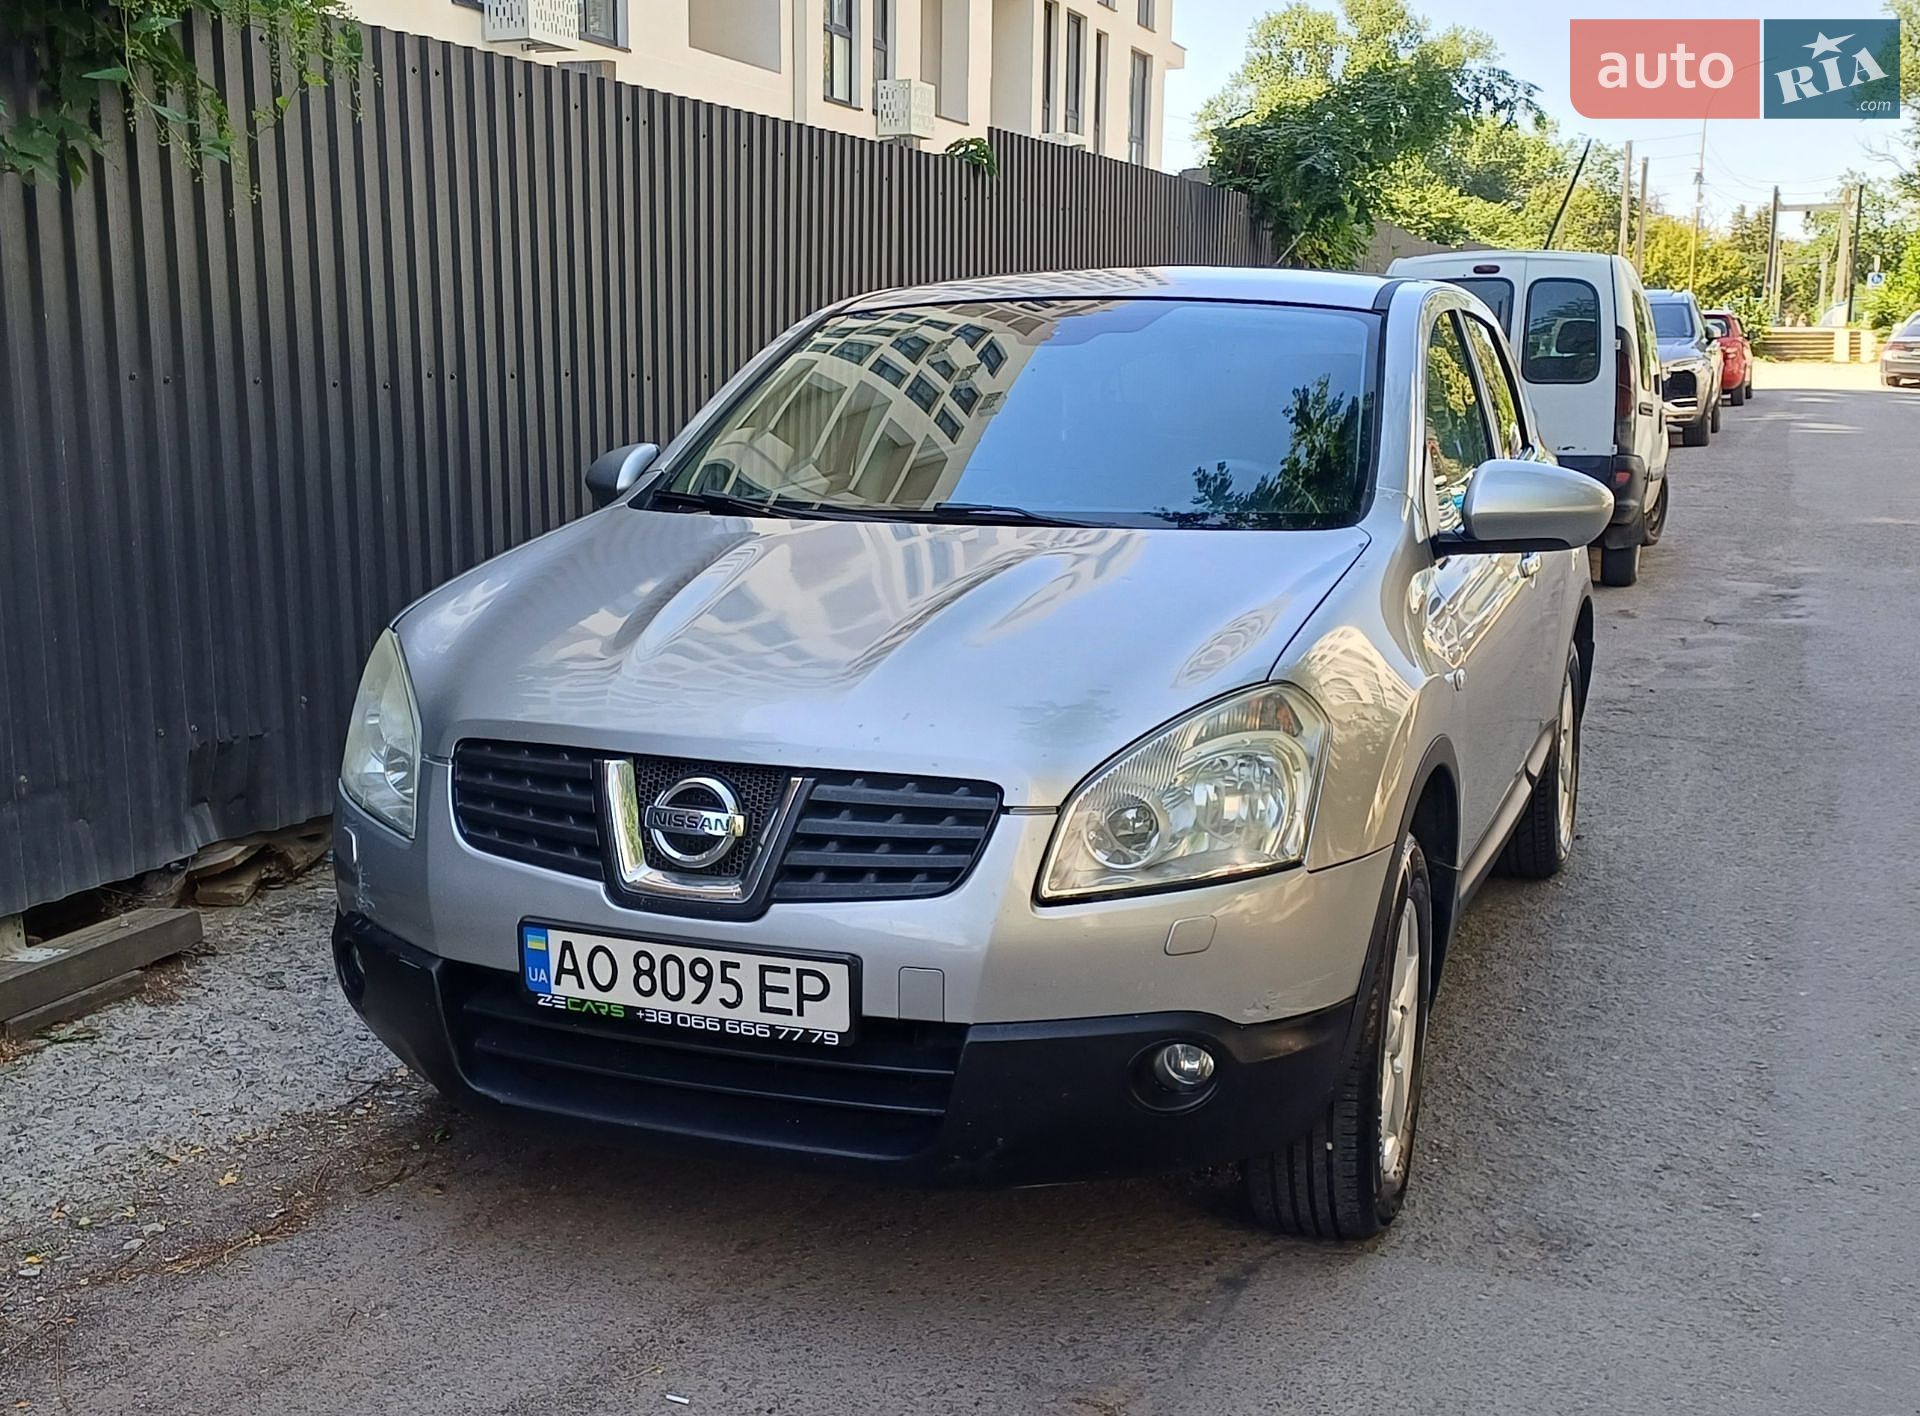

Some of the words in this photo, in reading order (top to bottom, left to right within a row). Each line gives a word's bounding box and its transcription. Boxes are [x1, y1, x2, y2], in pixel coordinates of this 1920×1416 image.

[652, 811, 730, 833] NISSAN
[528, 966, 549, 984] UA
[554, 940, 619, 993] AO
[632, 950, 744, 1010] 8095
[759, 964, 831, 1017] EP
[636, 1008, 672, 1025] +38
[677, 1014, 720, 1032] 066
[725, 1020, 770, 1038] 666
[775, 1025, 804, 1042] 77
[808, 1030, 839, 1046] 79
